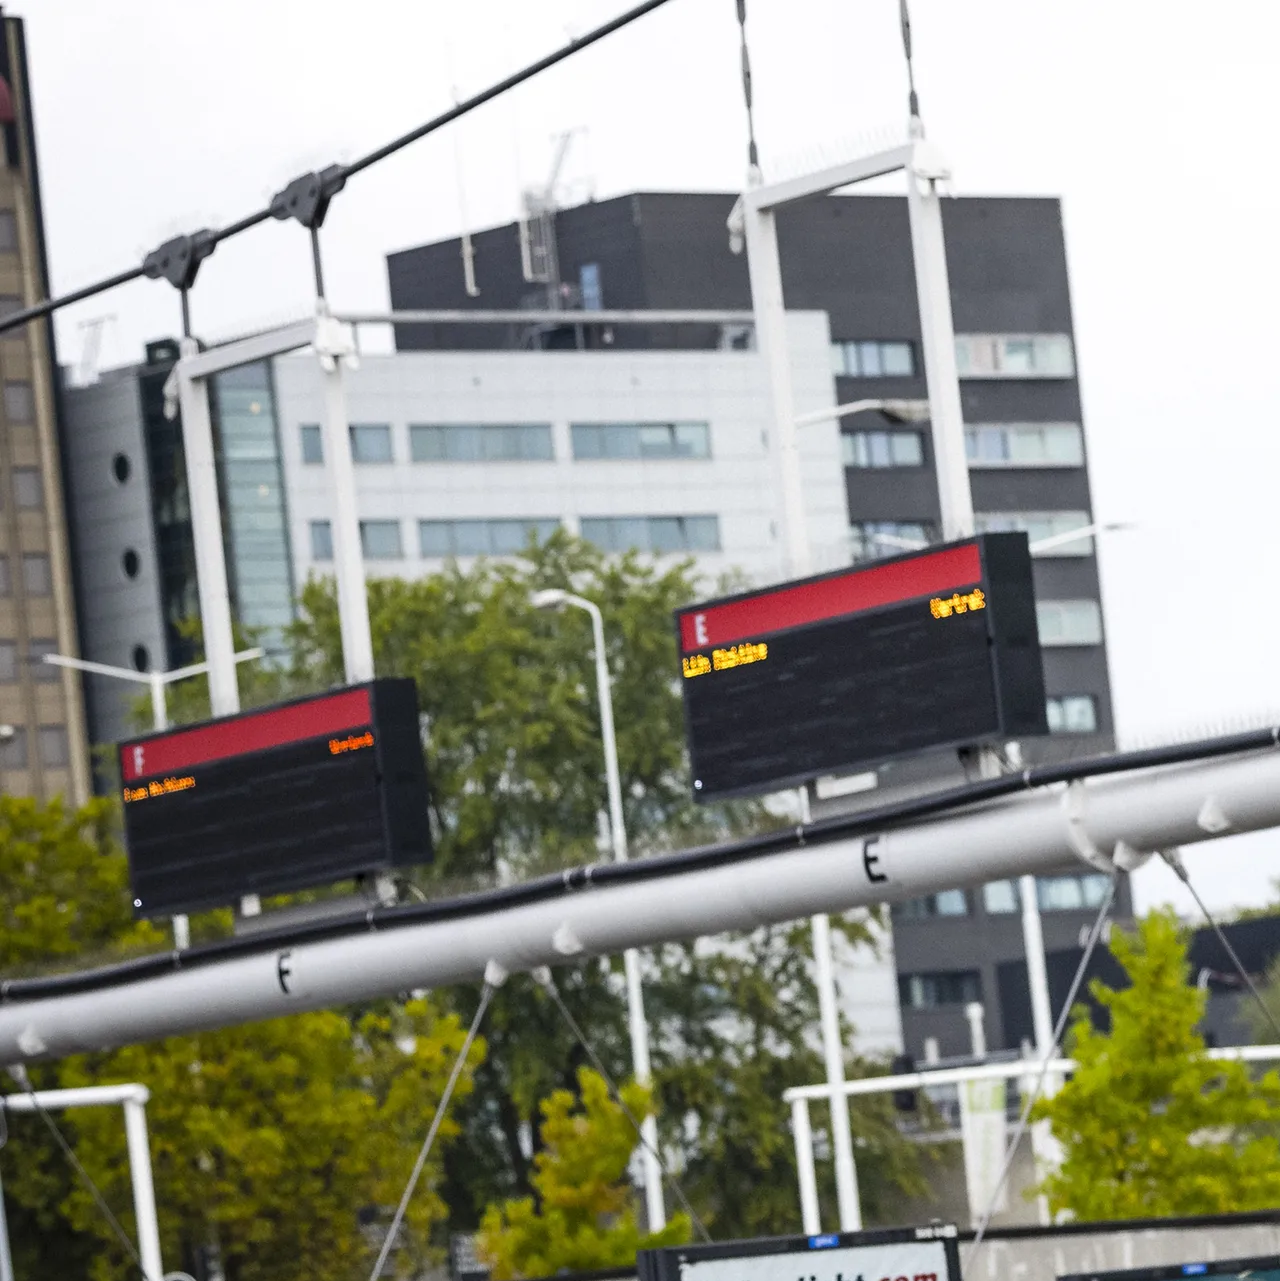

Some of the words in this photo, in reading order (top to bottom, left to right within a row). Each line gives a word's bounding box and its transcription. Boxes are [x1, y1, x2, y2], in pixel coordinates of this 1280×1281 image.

[694, 613, 709, 645] E
[863, 836, 888, 882] E
[277, 951, 291, 994] F
